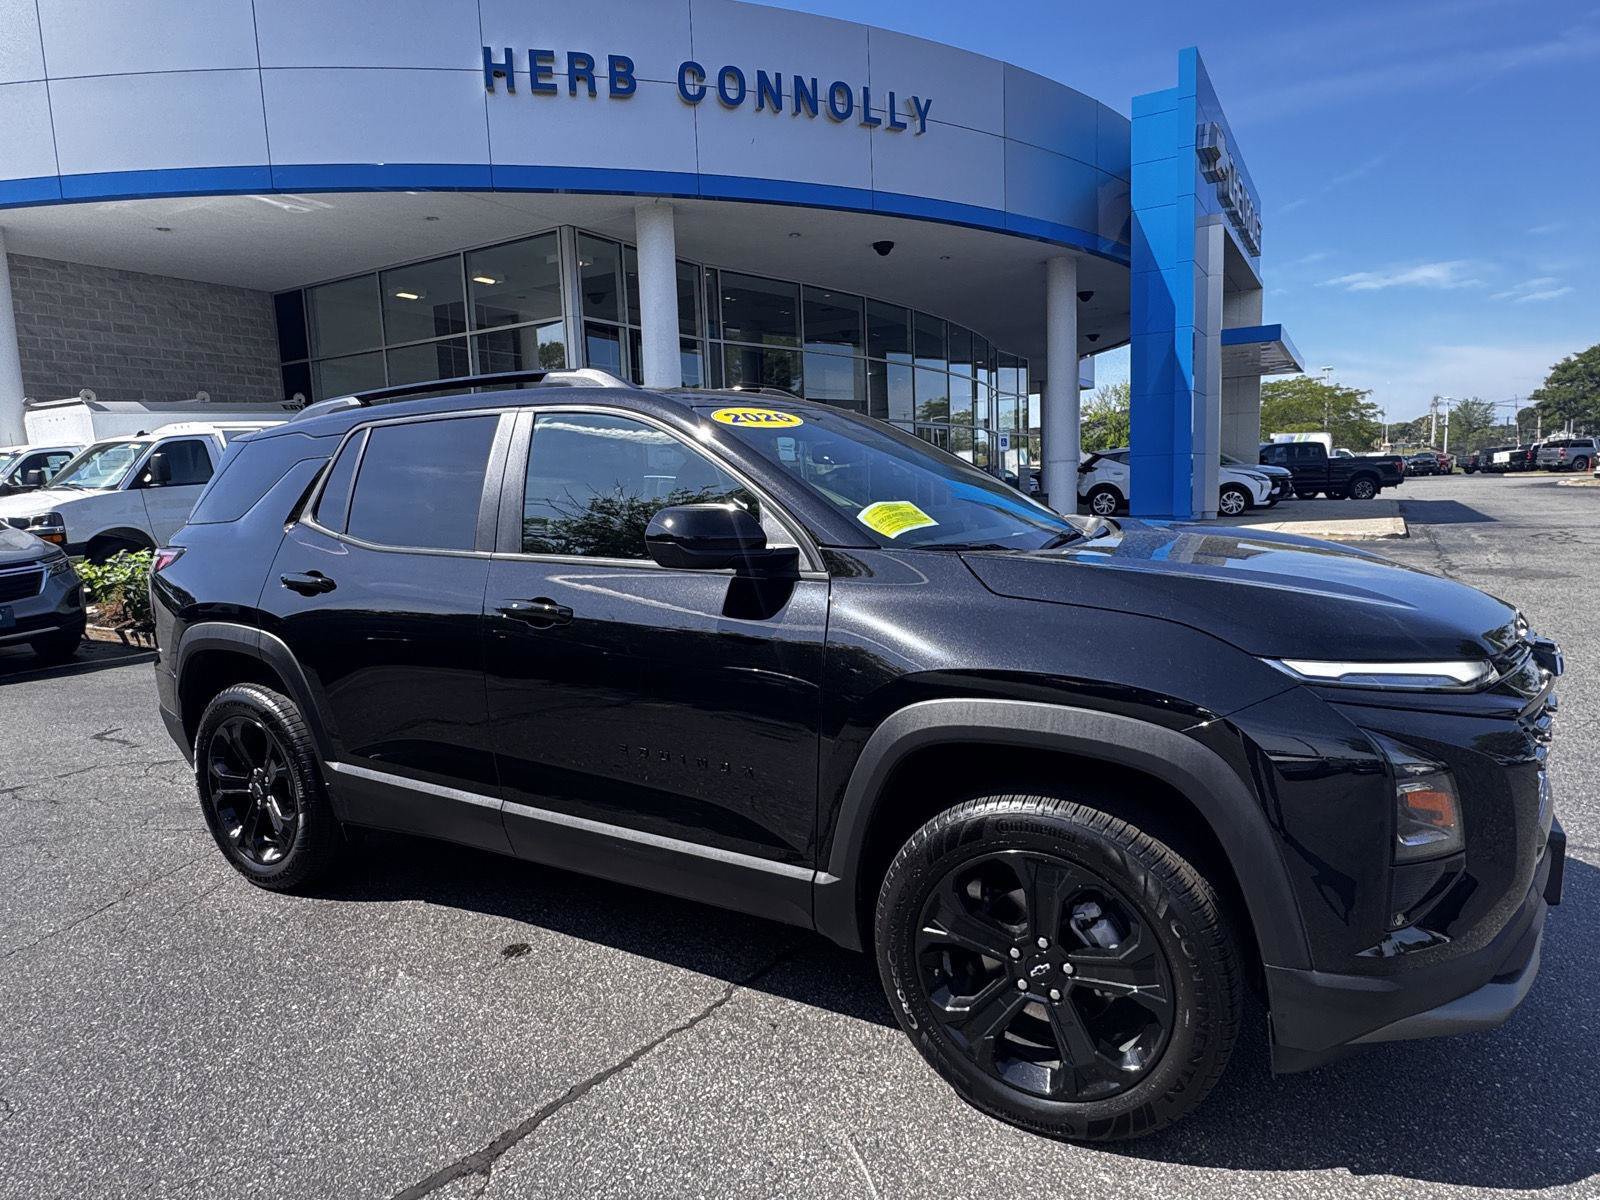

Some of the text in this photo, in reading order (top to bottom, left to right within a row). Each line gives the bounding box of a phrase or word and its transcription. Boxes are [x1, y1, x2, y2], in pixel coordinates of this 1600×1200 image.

[482, 46, 933, 136] HERB CONNOLLY
[723, 412, 793, 424] 2026
